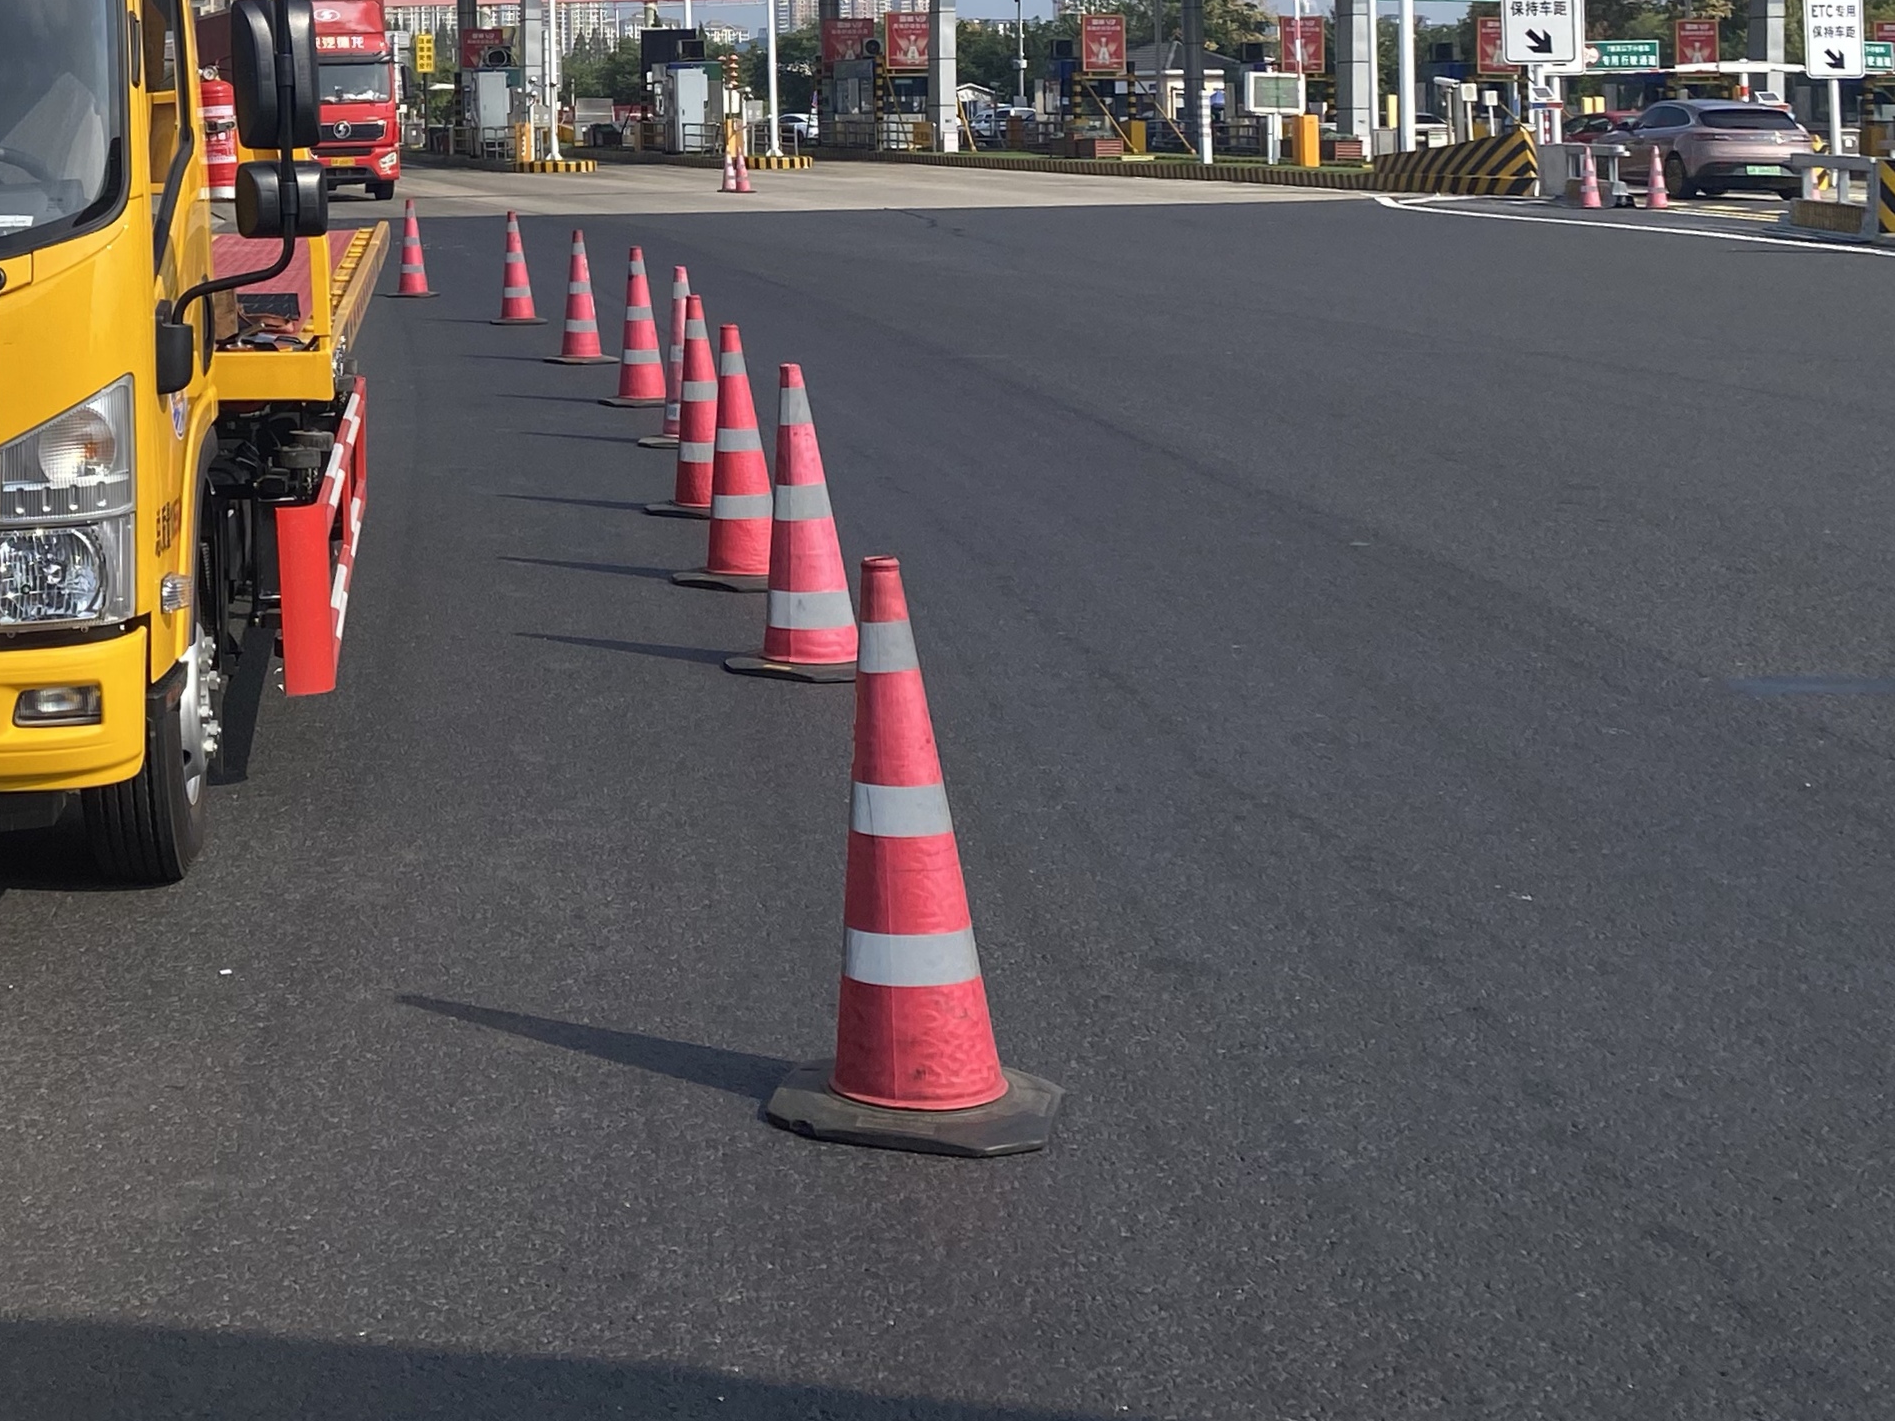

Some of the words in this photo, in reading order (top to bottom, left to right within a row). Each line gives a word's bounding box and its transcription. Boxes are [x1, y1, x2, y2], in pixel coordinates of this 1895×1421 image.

[1510, 0, 1568, 17] 保持车距
[1811, 4, 1834, 18] ETC
[1836, 4, 1856, 18] 专用
[1812, 26, 1857, 39] 保持车距
